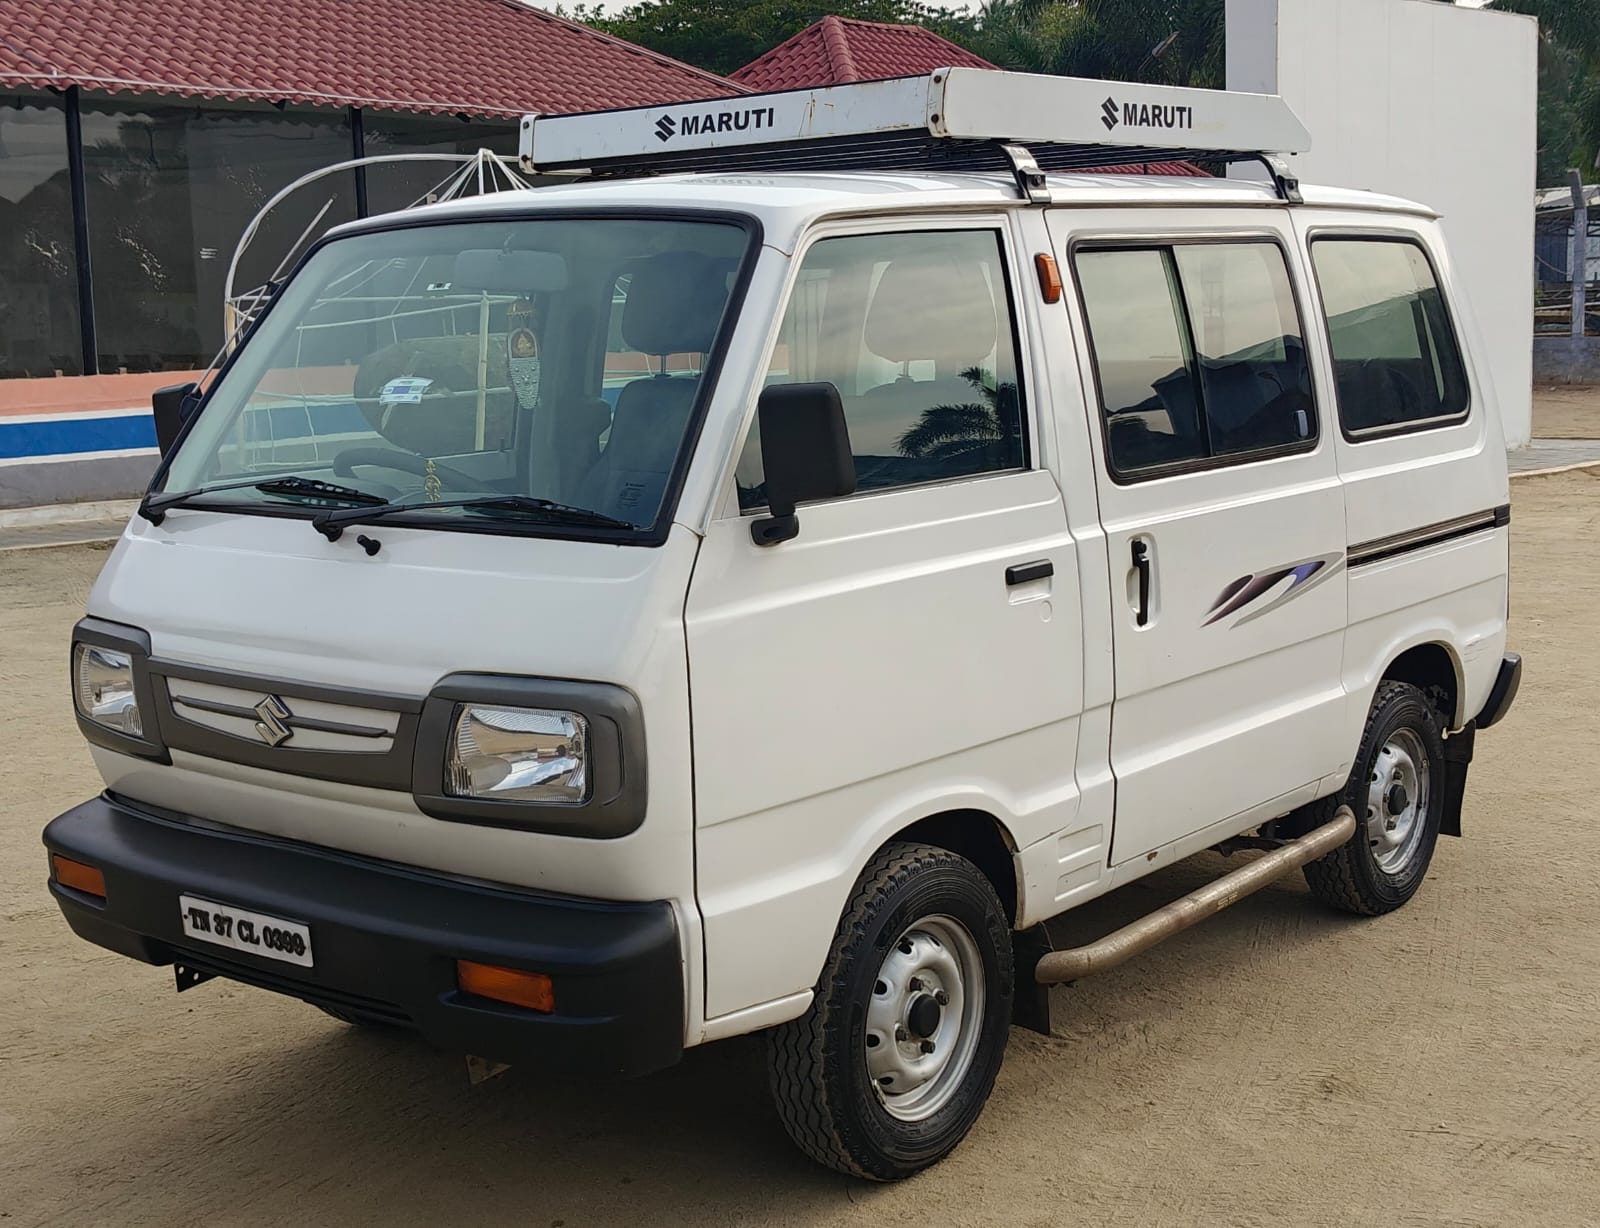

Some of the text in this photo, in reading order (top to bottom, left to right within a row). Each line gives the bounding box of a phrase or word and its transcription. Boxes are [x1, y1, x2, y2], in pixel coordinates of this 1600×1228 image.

[681, 107, 775, 136] MARUTI
[1123, 102, 1192, 129] MARUTI
[188, 907, 212, 933] TN
[237, 919, 260, 945] CL
[263, 925, 306, 957] 0399
